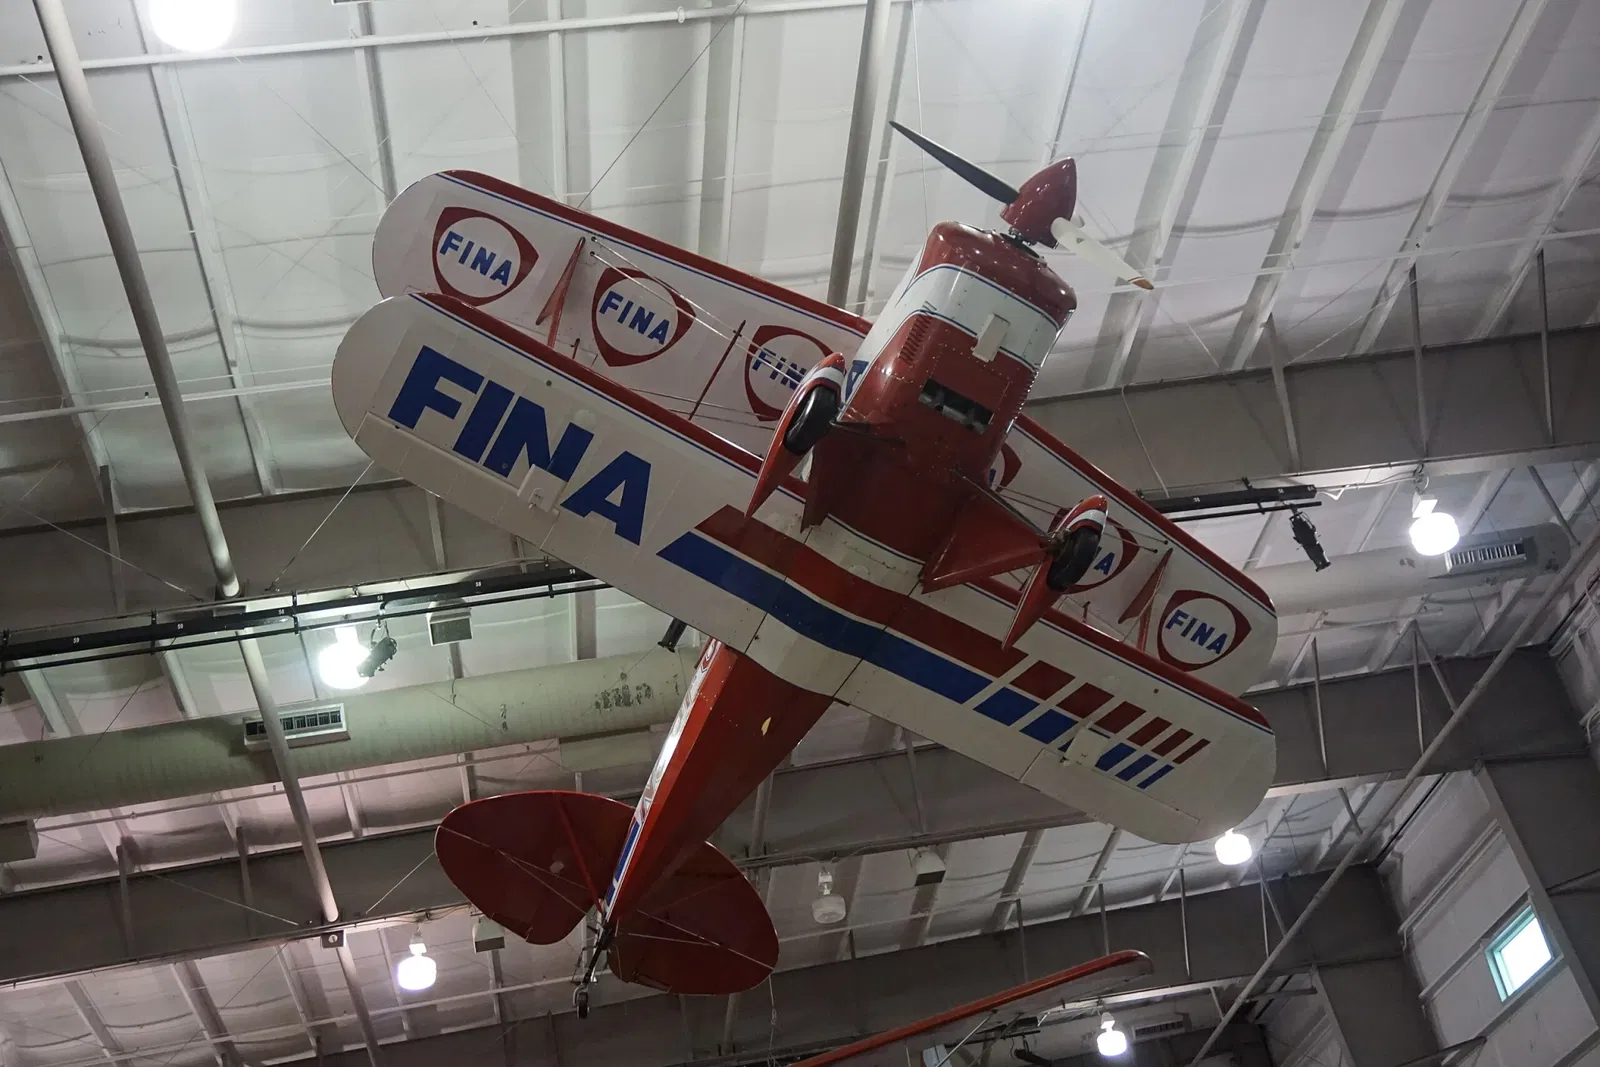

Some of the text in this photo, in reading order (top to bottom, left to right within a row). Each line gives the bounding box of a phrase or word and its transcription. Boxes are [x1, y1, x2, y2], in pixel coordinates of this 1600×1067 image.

[440, 231, 512, 286] FINA
[599, 290, 671, 346] FINA
[752, 347, 807, 391] FIN
[388, 345, 652, 546] FINA
[1166, 610, 1228, 655] FINA
